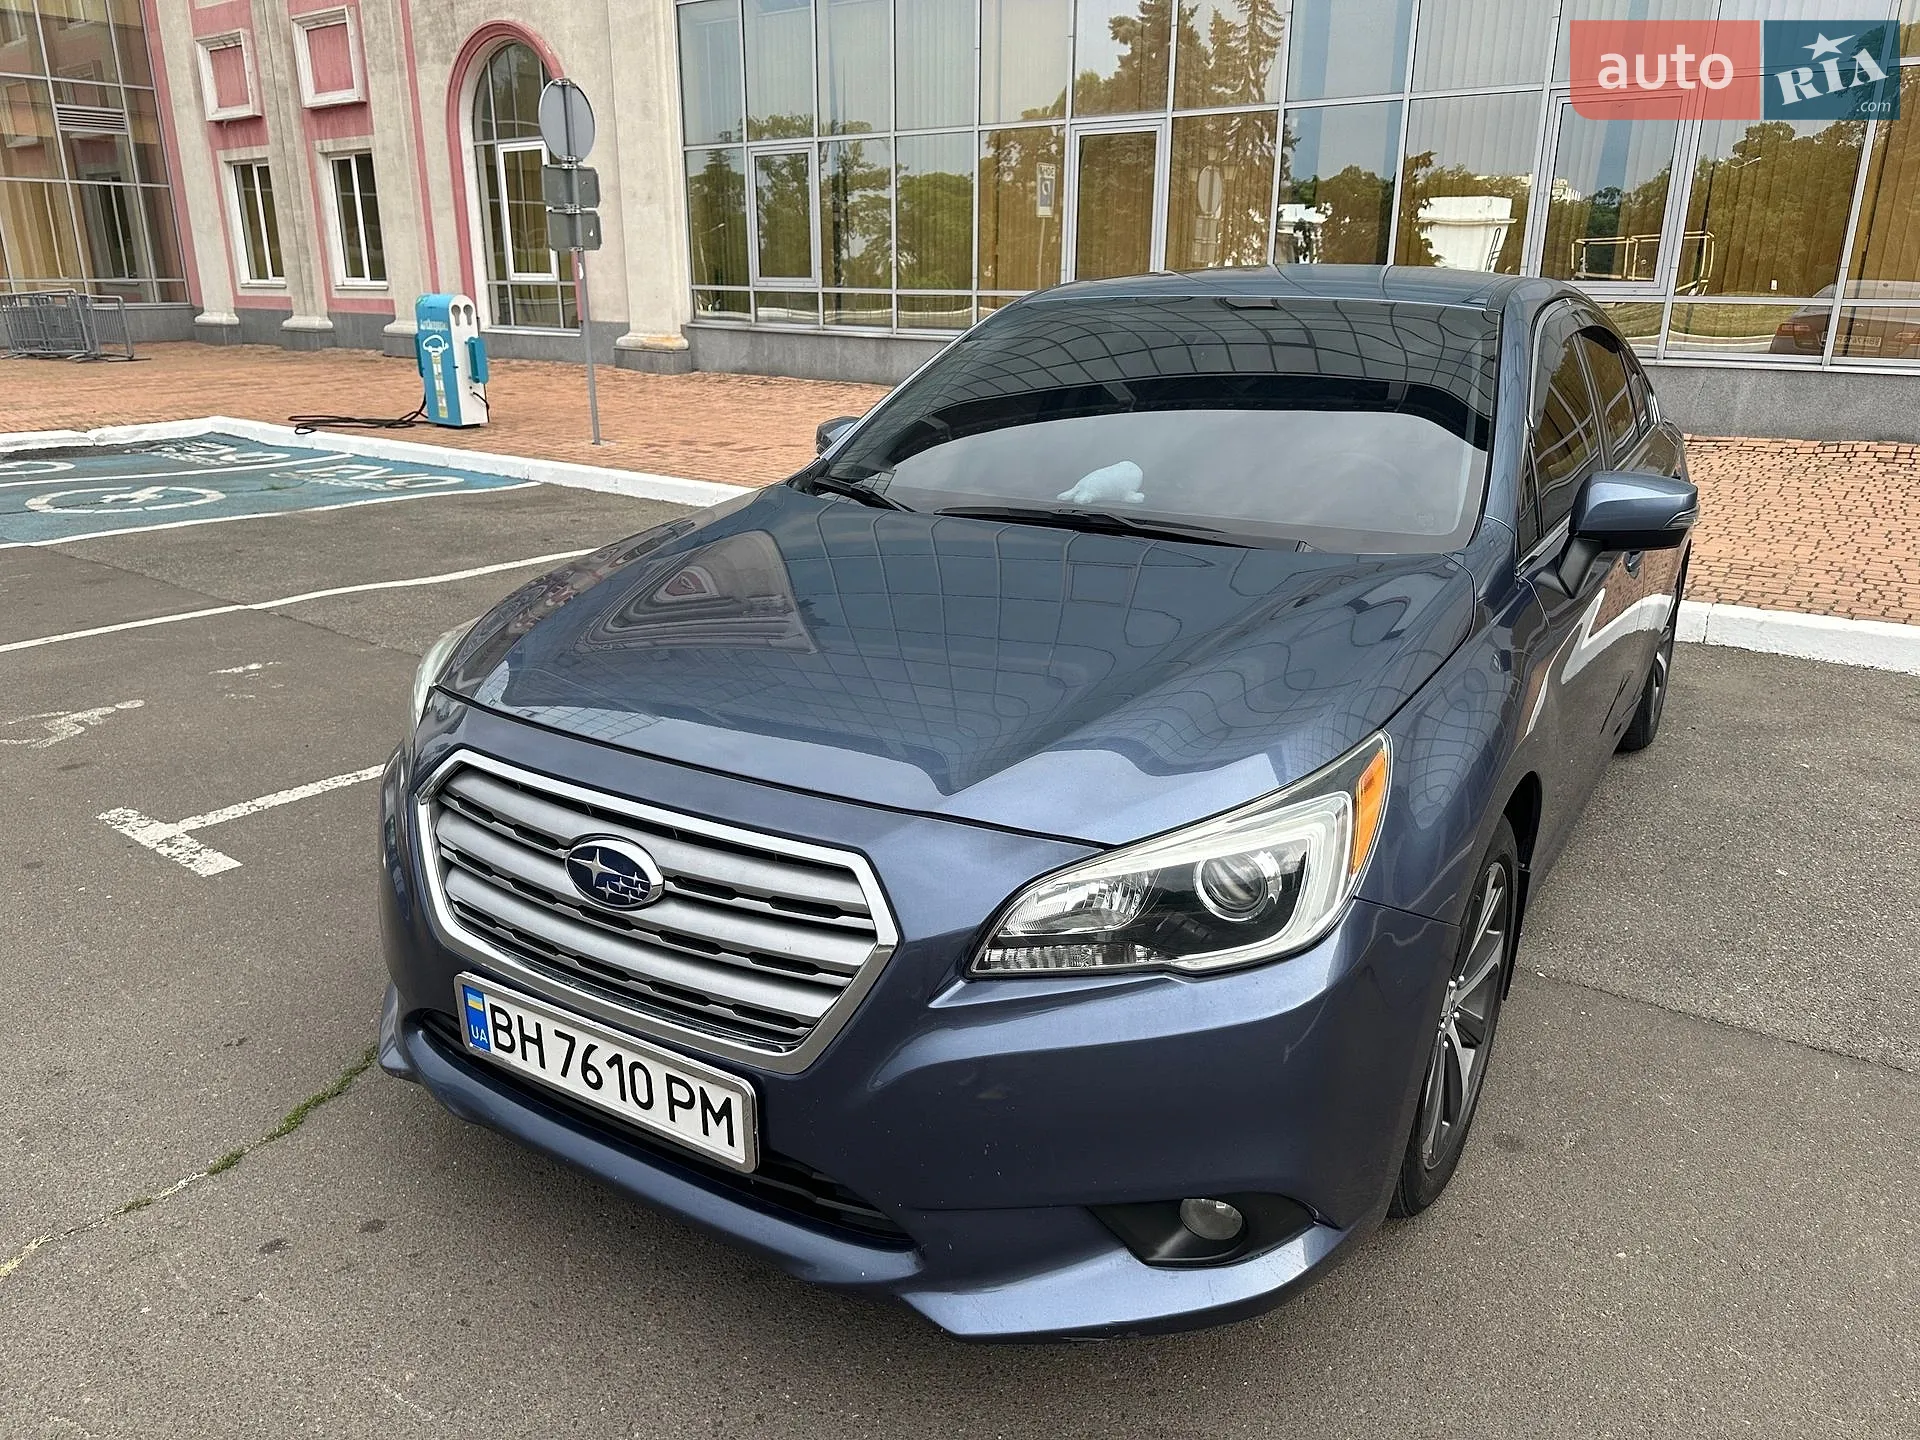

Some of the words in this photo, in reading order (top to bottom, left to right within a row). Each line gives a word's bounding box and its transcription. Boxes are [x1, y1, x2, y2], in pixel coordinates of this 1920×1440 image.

[471, 1024, 488, 1044] UA
[489, 1003, 546, 1070] BH
[554, 1029, 654, 1111] 7610
[665, 1073, 735, 1148] PM
